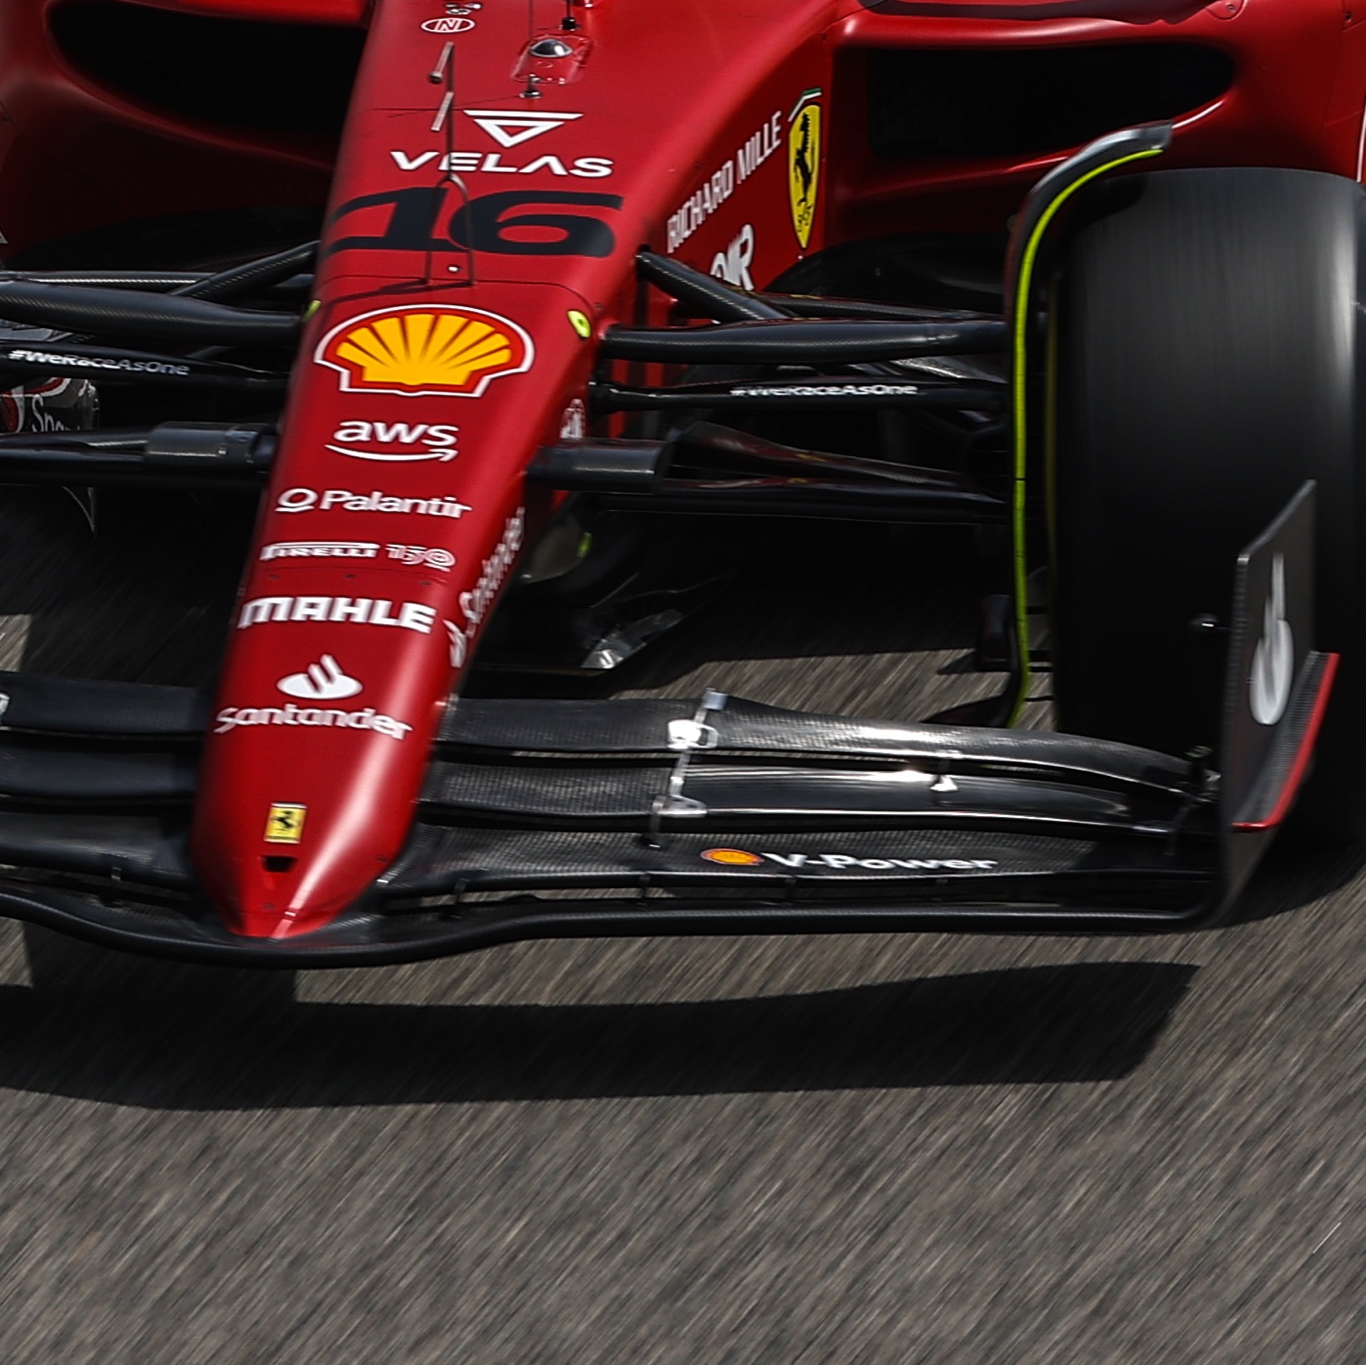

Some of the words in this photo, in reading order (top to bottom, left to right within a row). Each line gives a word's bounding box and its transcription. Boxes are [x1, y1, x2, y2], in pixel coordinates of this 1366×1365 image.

[389, 151, 613, 178] VELAS
[667, 160, 733, 253] RICHARD
[737, 111, 781, 184] MILLE
[324, 187, 623, 258] 16
[333, 420, 459, 447] aws
[319, 490, 472, 518] Palantir
[260, 542, 380, 561] PIRELLI
[236, 596, 437, 634] MAHLE
[761, 852, 998, 869] V-Power
